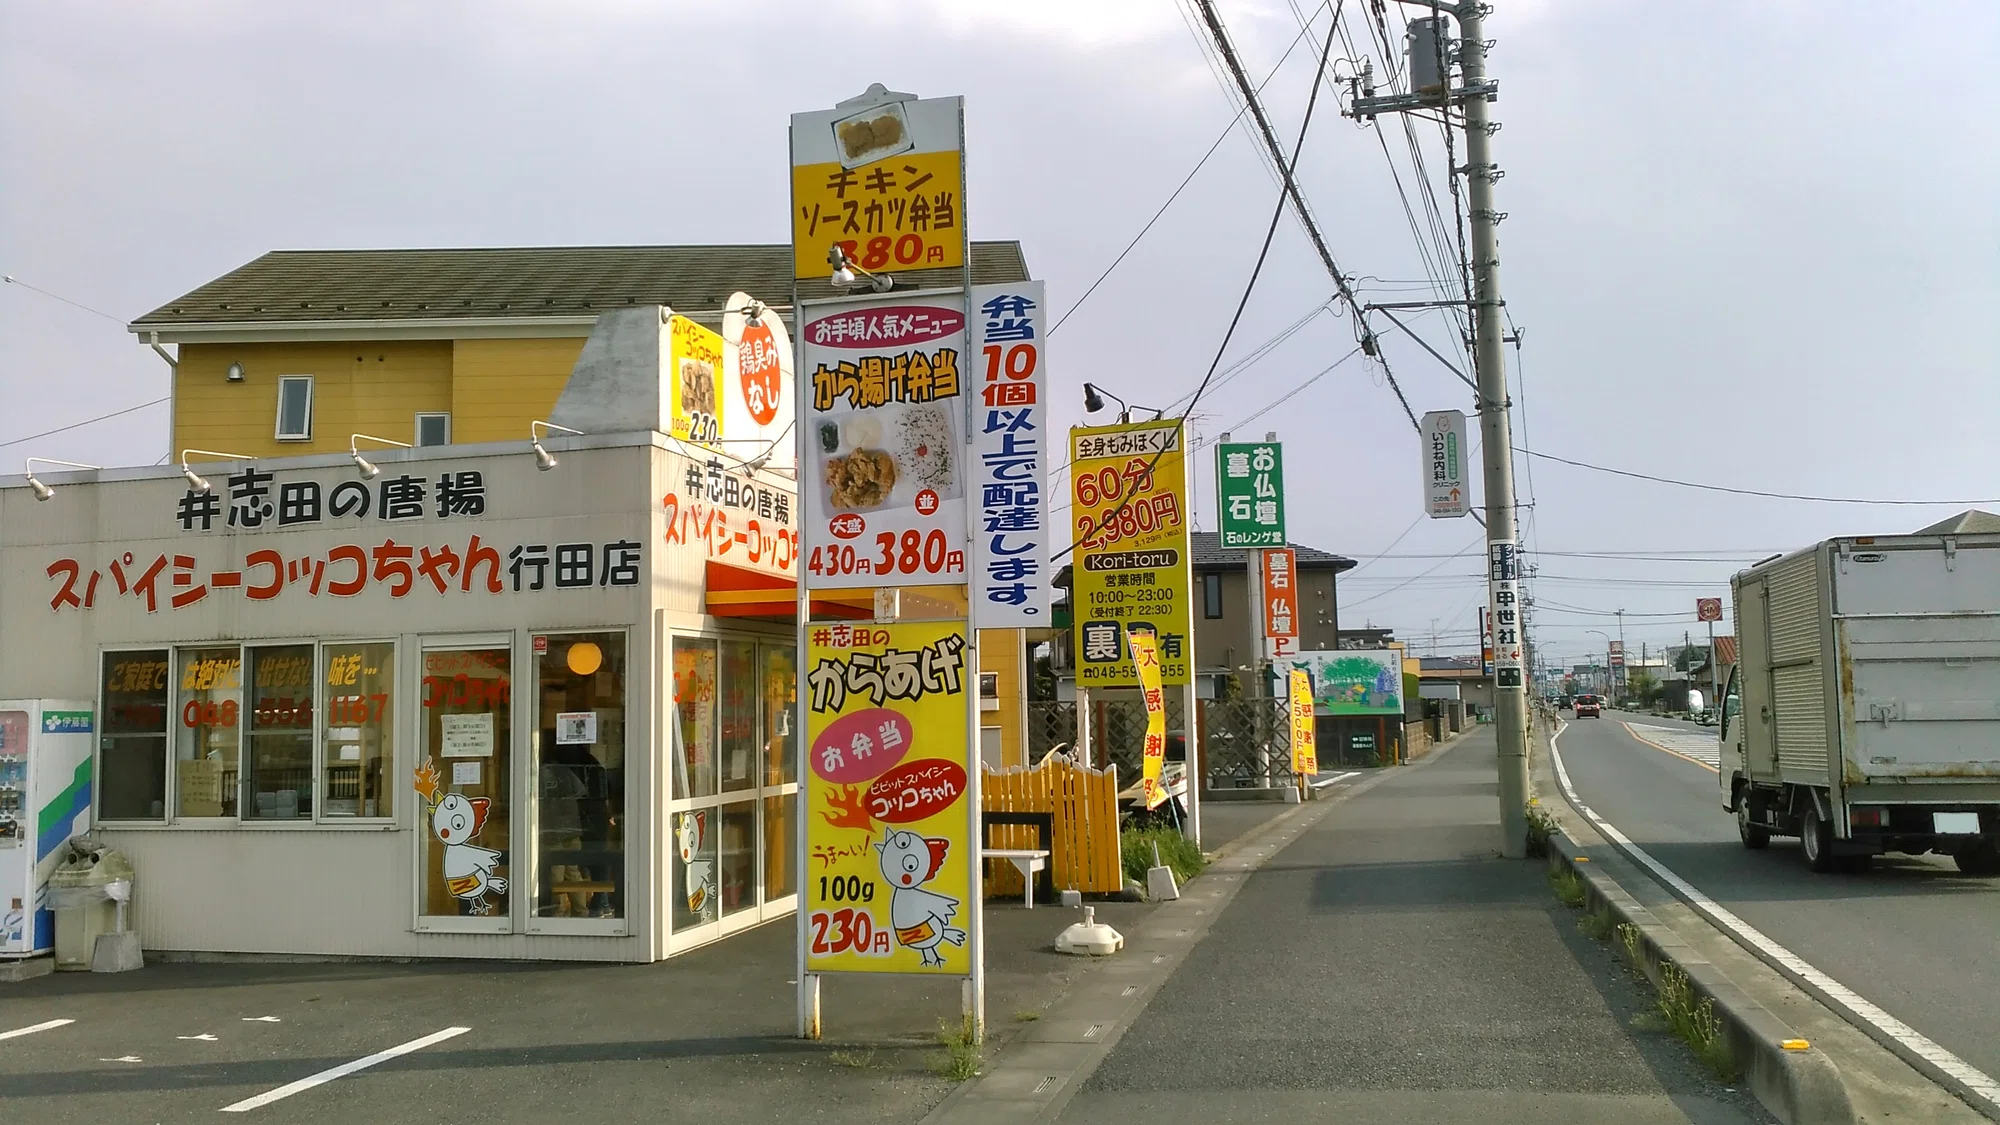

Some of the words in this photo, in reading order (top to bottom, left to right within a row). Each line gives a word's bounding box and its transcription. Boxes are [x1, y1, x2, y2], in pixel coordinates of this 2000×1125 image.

[826, 165, 933, 199] チキン
[802, 191, 954, 238] ソースカツ弁当
[815, 314, 957, 343] お手頃人気メニュー
[740, 336, 778, 375] 鶏臭み
[748, 376, 779, 414] なし
[812, 347, 960, 411] から揚げ弁当
[981, 295, 1040, 615] 弁当10個以上で配達します。
[1079, 431, 1175, 457] 全身もみほぐし
[176, 467, 485, 531] 井志田の唐揚
[686, 456, 788, 525] 井志田の唐揚
[1077, 458, 1153, 507] 60分
[1227, 453, 1251, 520] 墓石
[1253, 447, 1277, 525] お仏壇
[919, 496, 935, 511] 並
[1077, 492, 1180, 551] 2,980円
[832, 518, 863, 535] 大盛
[1226, 531, 1282, 543] 石のレンゲ堂
[808, 545, 870, 576] 430円
[874, 529, 964, 575] 380円
[1091, 552, 1170, 569] Kori-toru
[1105, 573, 1155, 587] 営業時間
[813, 624, 890, 647] 井志田の
[1086, 625, 1117, 659] 裏
[1160, 632, 1183, 658] 有
[1275, 638, 1289, 650] P
[808, 633, 966, 713] からあげ
[183, 699, 238, 728] 048
[330, 693, 388, 725] 1167
[822, 720, 902, 772] お弁当
[872, 779, 957, 817] コッコちゃん
[820, 875, 874, 902] 100g
[811, 908, 890, 954] 230円
